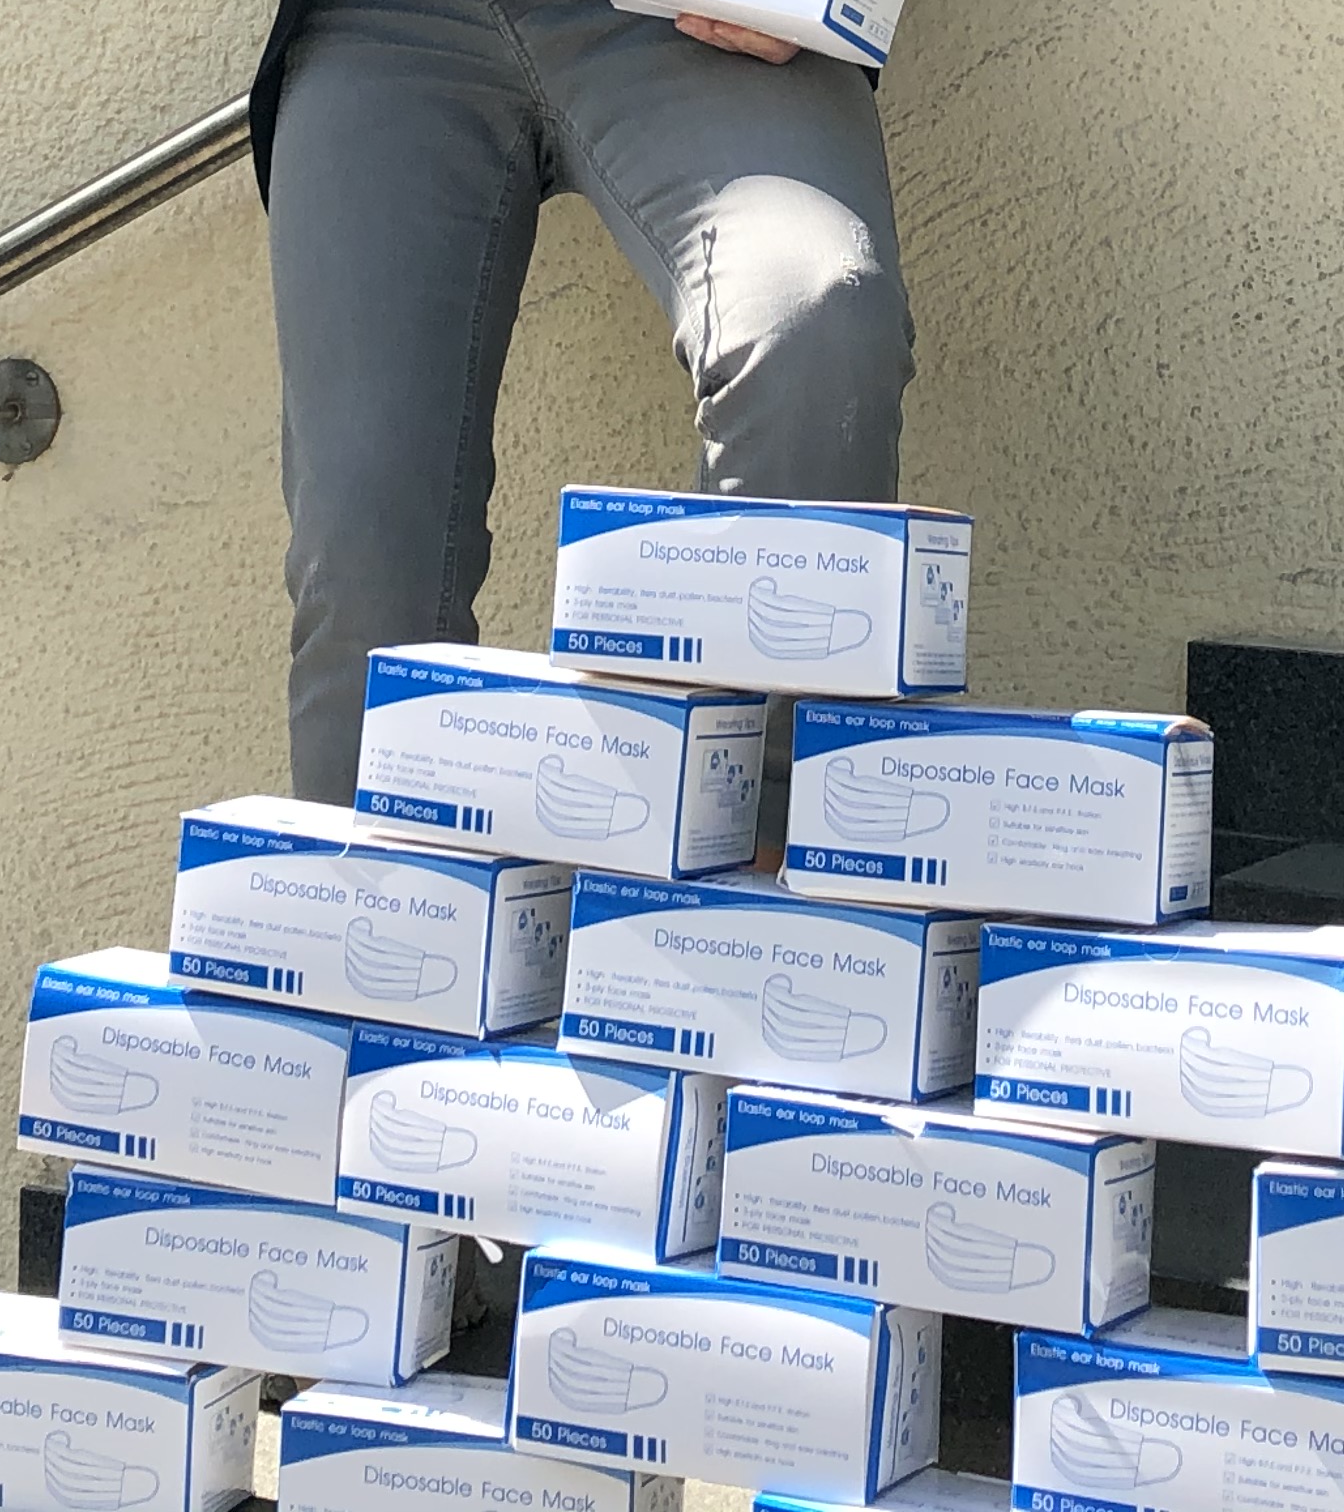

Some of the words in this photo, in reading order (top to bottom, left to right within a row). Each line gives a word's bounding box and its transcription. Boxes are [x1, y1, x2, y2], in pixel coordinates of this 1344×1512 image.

[639, 540, 748, 566] Disposable
[755, 547, 808, 570] Face
[815, 551, 870, 574] Mask
[567, 633, 589, 651] 50
[592, 634, 643, 655] Pieces
[438, 709, 539, 743] Disposable
[544, 725, 594, 751] Face
[600, 733, 651, 760] Mask
[844, 715, 865, 728] ear
[868, 715, 895, 733] loop
[898, 720, 930, 734] mask
[880, 756, 995, 787] Disposable
[1004, 768, 1060, 793] Face
[1068, 774, 1126, 799] Mask
[369, 794, 390, 814] 50
[392, 798, 439, 822] Pieces
[803, 850, 827, 870] 50
[830, 852, 884, 876] Pieces
[249, 872, 348, 905] Disposable
[353, 887, 402, 913] Face
[408, 895, 458, 922] Mask
[653, 928, 764, 962] Disposable
[770, 943, 824, 970] Face
[831, 951, 887, 978] Mask
[1026, 940, 1048, 952] ear
[1050, 940, 1077, 957] loop
[1080, 944, 1112, 958] mask
[181, 956, 202, 974] 50
[204, 959, 250, 983] Pieces
[1063, 982, 1179, 1014] Disposable
[1187, 994, 1244, 1021] Face
[1252, 1001, 1310, 1028] Mask
[577, 1018, 600, 1038] 50
[602, 1021, 655, 1046] Pieces
[101, 1025, 202, 1061] Disposable
[207, 1043, 256, 1071] Face
[262, 1052, 313, 1081] Mask
[419, 1079, 520, 1114] Disposable
[525, 1096, 574, 1124] Face
[581, 1104, 632, 1133] Mask
[988, 1079, 1012, 1099] 50
[1015, 1082, 1069, 1106] Pieces
[31, 1118, 53, 1139] 50
[54, 1123, 102, 1148] Pieces
[350, 1179, 372, 1200] 50
[374, 1183, 421, 1208] Pieces
[811, 1152, 924, 1189] Disposable
[932, 1170, 987, 1199] Face
[995, 1179, 1052, 1208] Mask
[1313, 1187, 1336, 1200] ear
[144, 1226, 251, 1258] Disposable
[257, 1240, 309, 1266] Face
[316, 1248, 369, 1274] Mask
[737, 1243, 761, 1264] 50
[763, 1247, 817, 1273] Pieces
[72, 1312, 95, 1330] 50
[97, 1315, 147, 1338] Pieces
[602, 1316, 712, 1353] Disposable
[719, 1334, 772, 1364] Face
[780, 1343, 835, 1374] Mask
[1276, 1333, 1302, 1354] 50
[1070, 1351, 1092, 1366] ear
[1096, 1352, 1123, 1373] loop
[1127, 1361, 1161, 1377] mask
[50, 1401, 99, 1427] Face
[106, 1409, 156, 1434] Mask
[1108, 1397, 1230, 1438] Disposable
[1240, 1419, 1298, 1449] Face
[530, 1419, 553, 1442] 50
[556, 1424, 608, 1450] Pieces
[364, 1464, 473, 1497] Disposable
[480, 1480, 534, 1506] Face
[541, 1488, 596, 1512] Mask
[1030, 1492, 1054, 1512] 50
